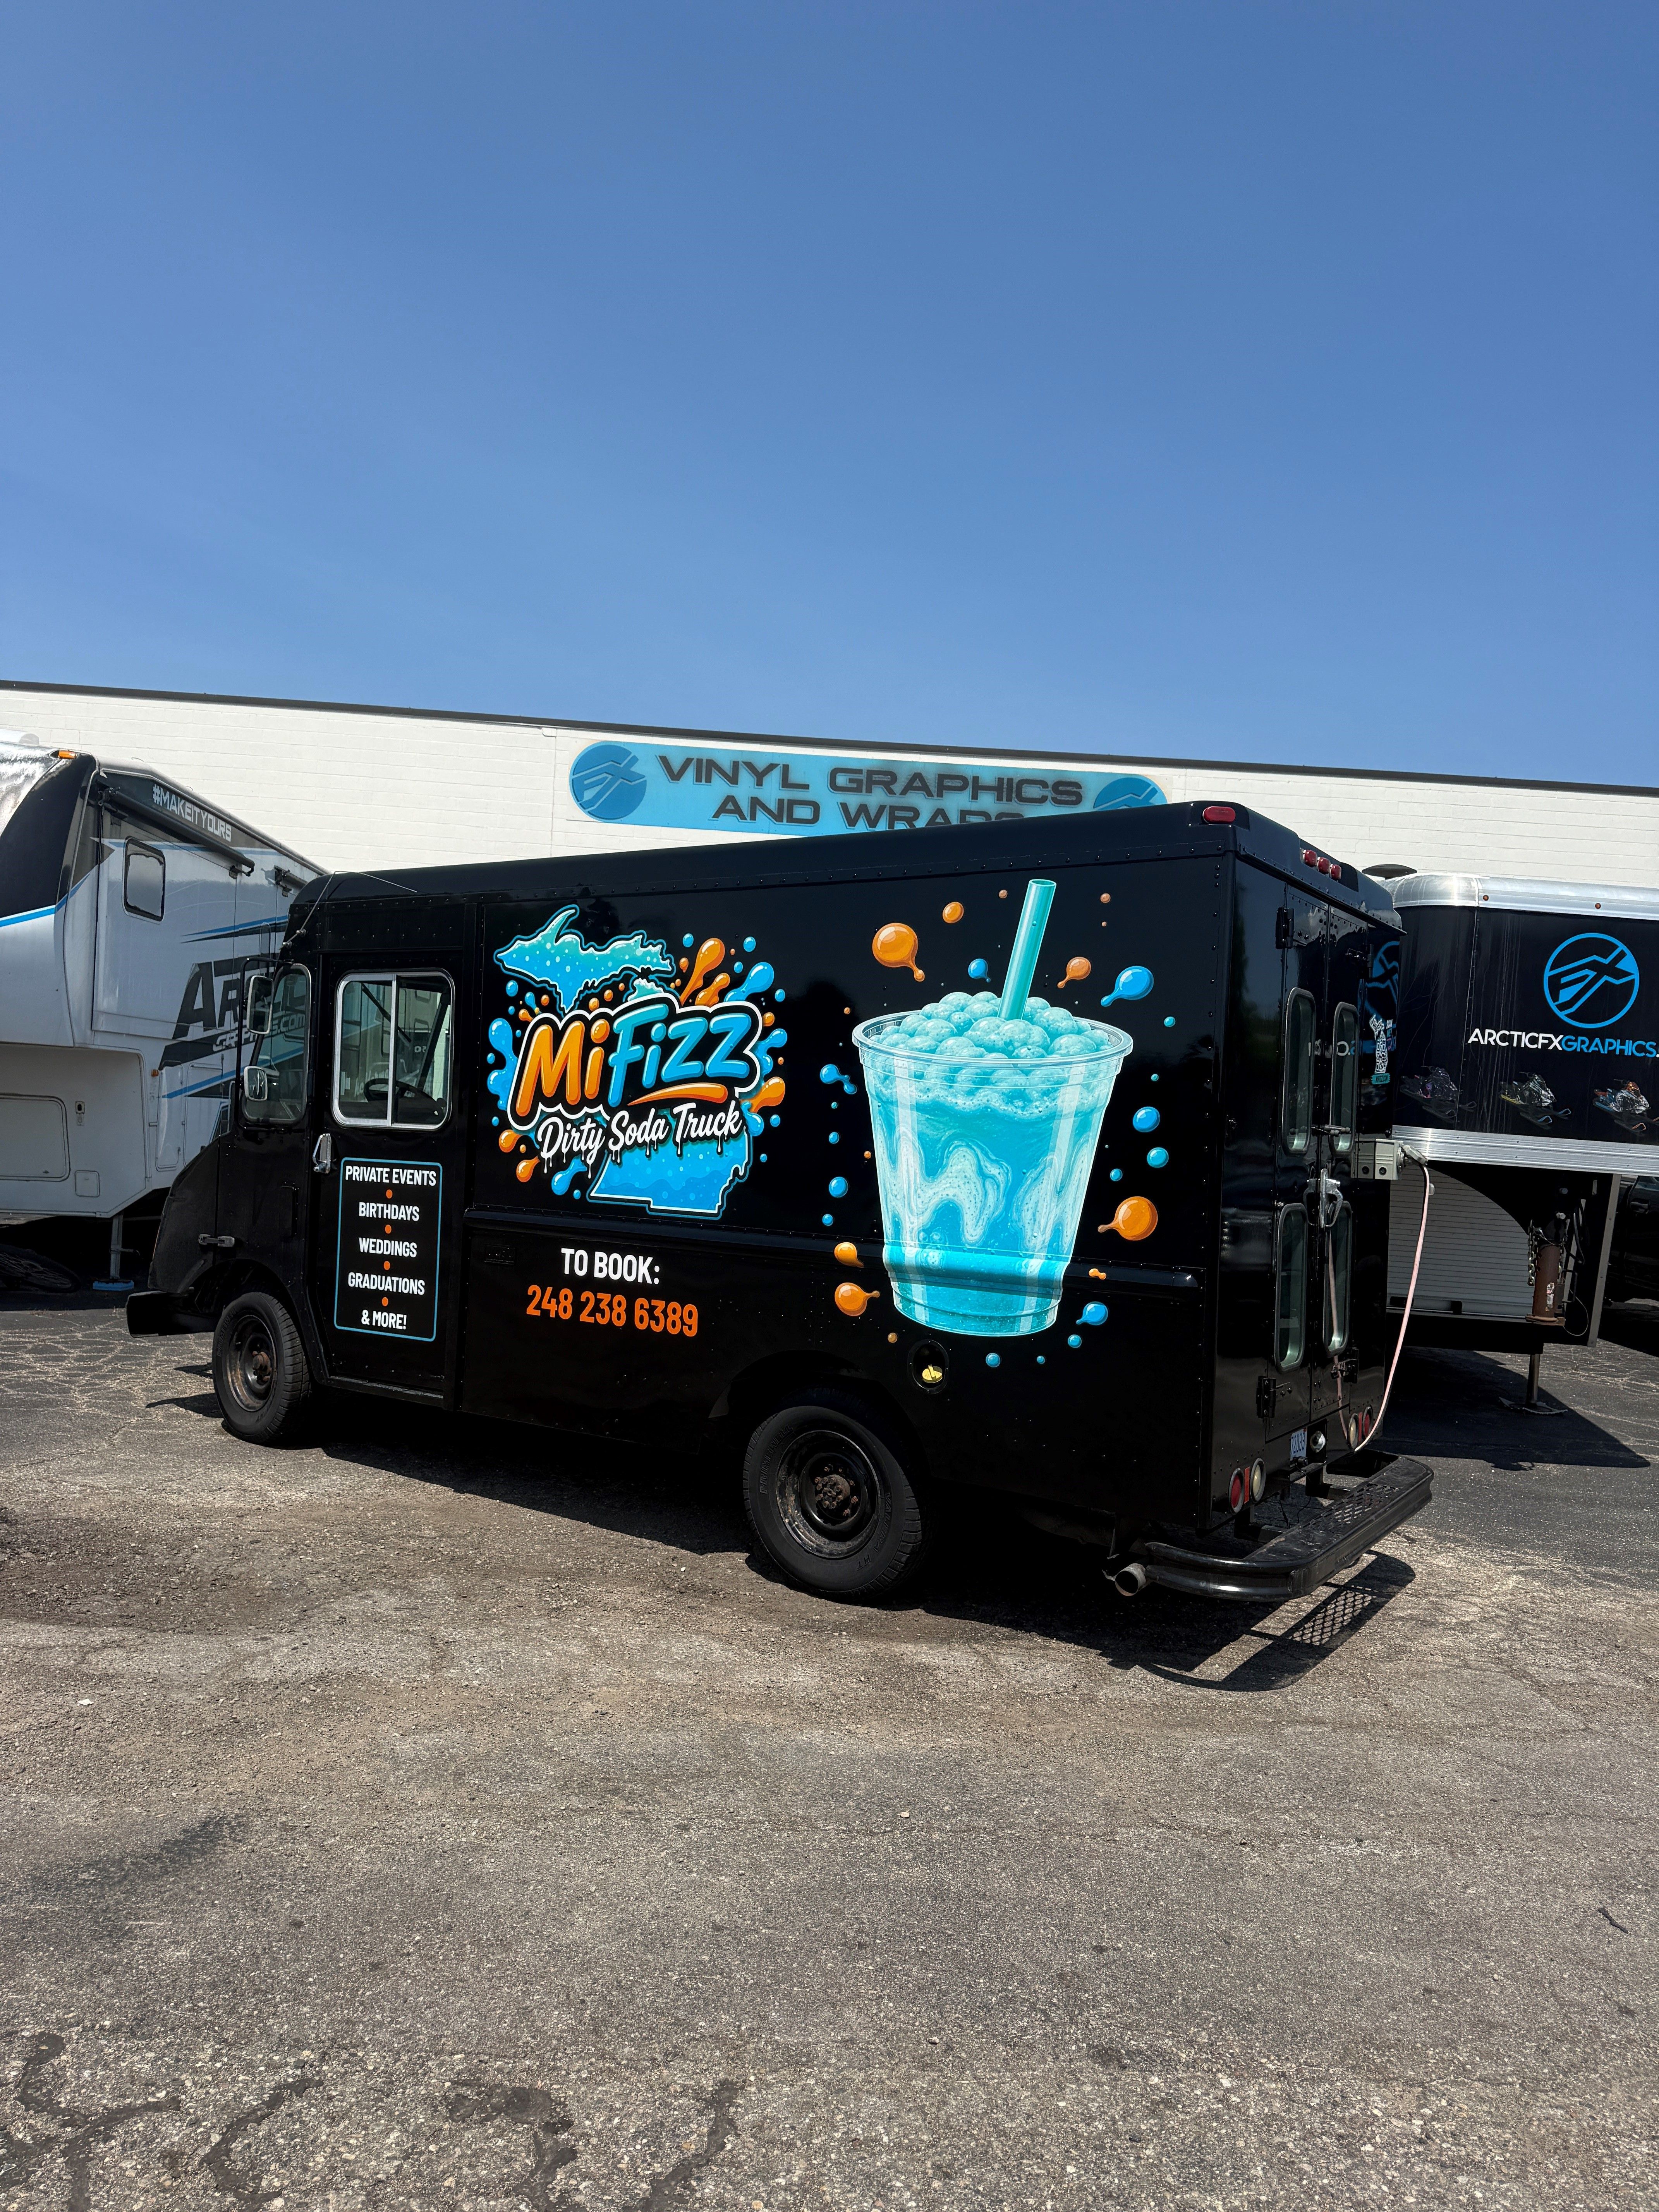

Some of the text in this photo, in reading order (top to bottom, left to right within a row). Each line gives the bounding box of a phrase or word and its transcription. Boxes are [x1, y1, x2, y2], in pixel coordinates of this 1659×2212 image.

[657, 755, 1082, 805] VINYL GRAPHICS
[153, 784, 232, 842] #MAKEITYOURS
[708, 795, 820, 826] AND
[538, 1100, 743, 1170] Dirty Soda Truck
[345, 1166, 436, 1186] PRIVATE EVENTS
[359, 1202, 419, 1221] BIRTHDAYS
[359, 1237, 417, 1258] WEDDINGS
[561, 1248, 660, 1285] TO BOOK:
[348, 1272, 425, 1295] GRADUATIONS
[361, 1309, 407, 1330] & MORE!
[526, 1285, 698, 1337] 248 238 6389
